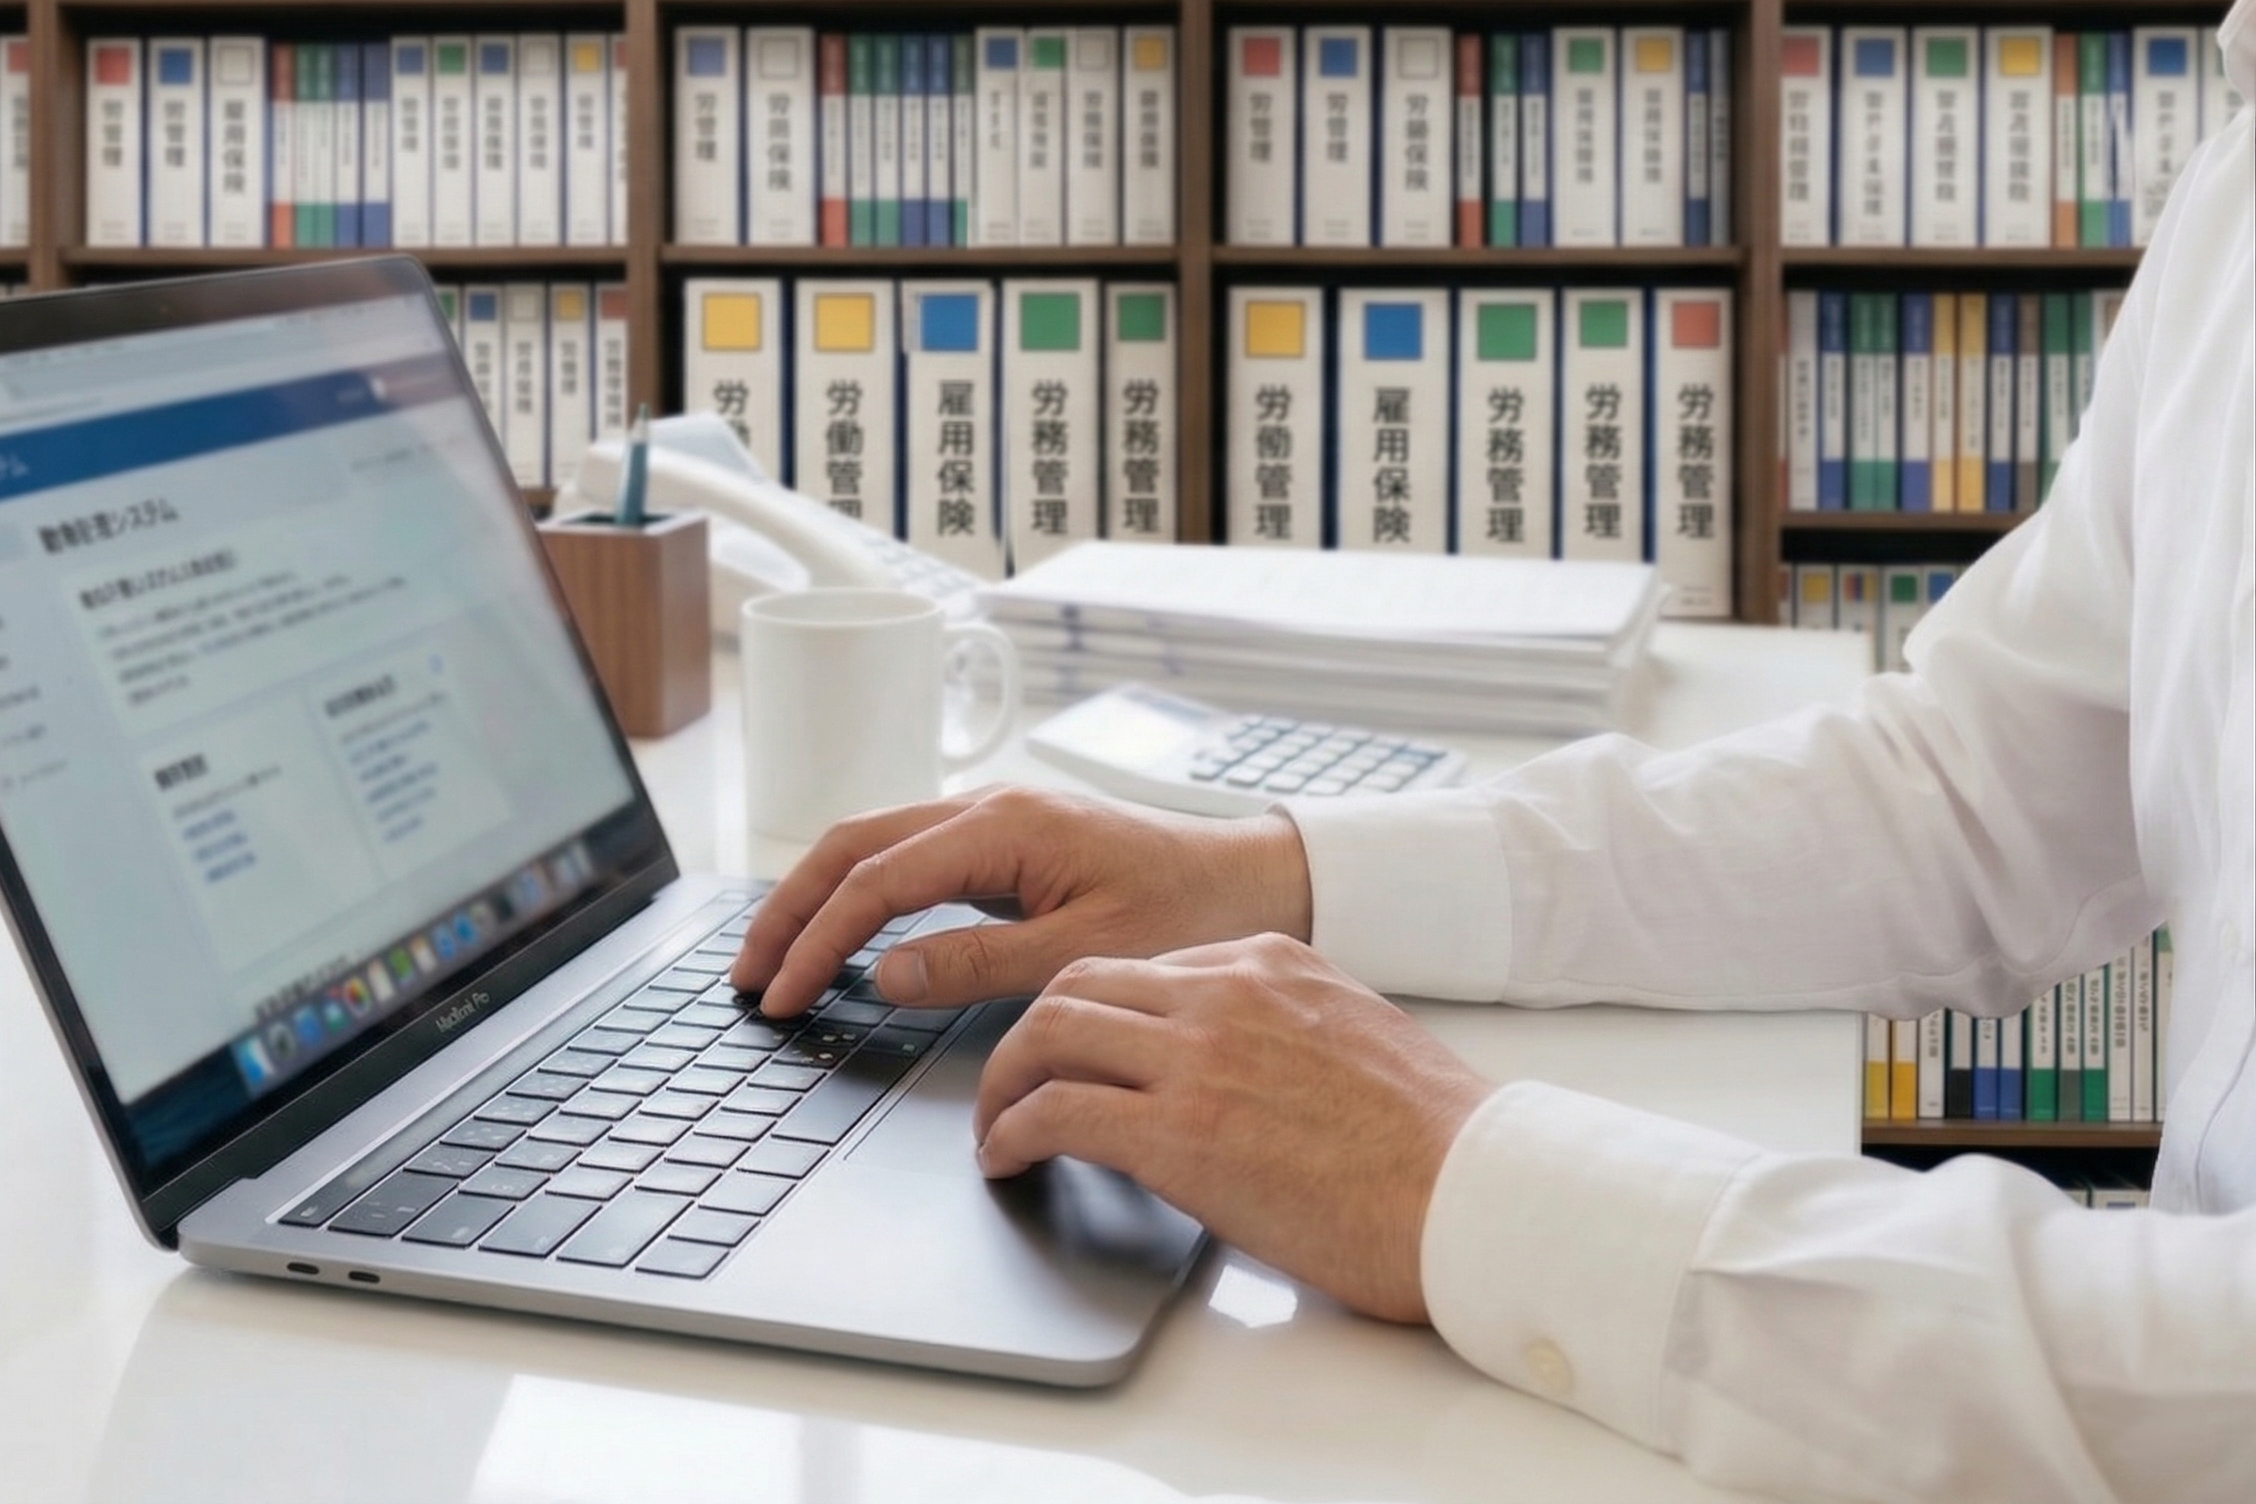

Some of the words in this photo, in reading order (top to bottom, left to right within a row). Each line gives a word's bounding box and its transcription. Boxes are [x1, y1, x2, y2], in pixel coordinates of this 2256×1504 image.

[937, 380, 975, 536] 雇用保険
[1031, 380, 1069, 536] 労務管理
[1122, 380, 1161, 535] 労務管理
[1372, 386, 1411, 544] 雇用保険
[1486, 387, 1525, 544] 労務管理
[1584, 383, 1622, 540] 労務管理
[1676, 383, 1715, 540] 労務管理
